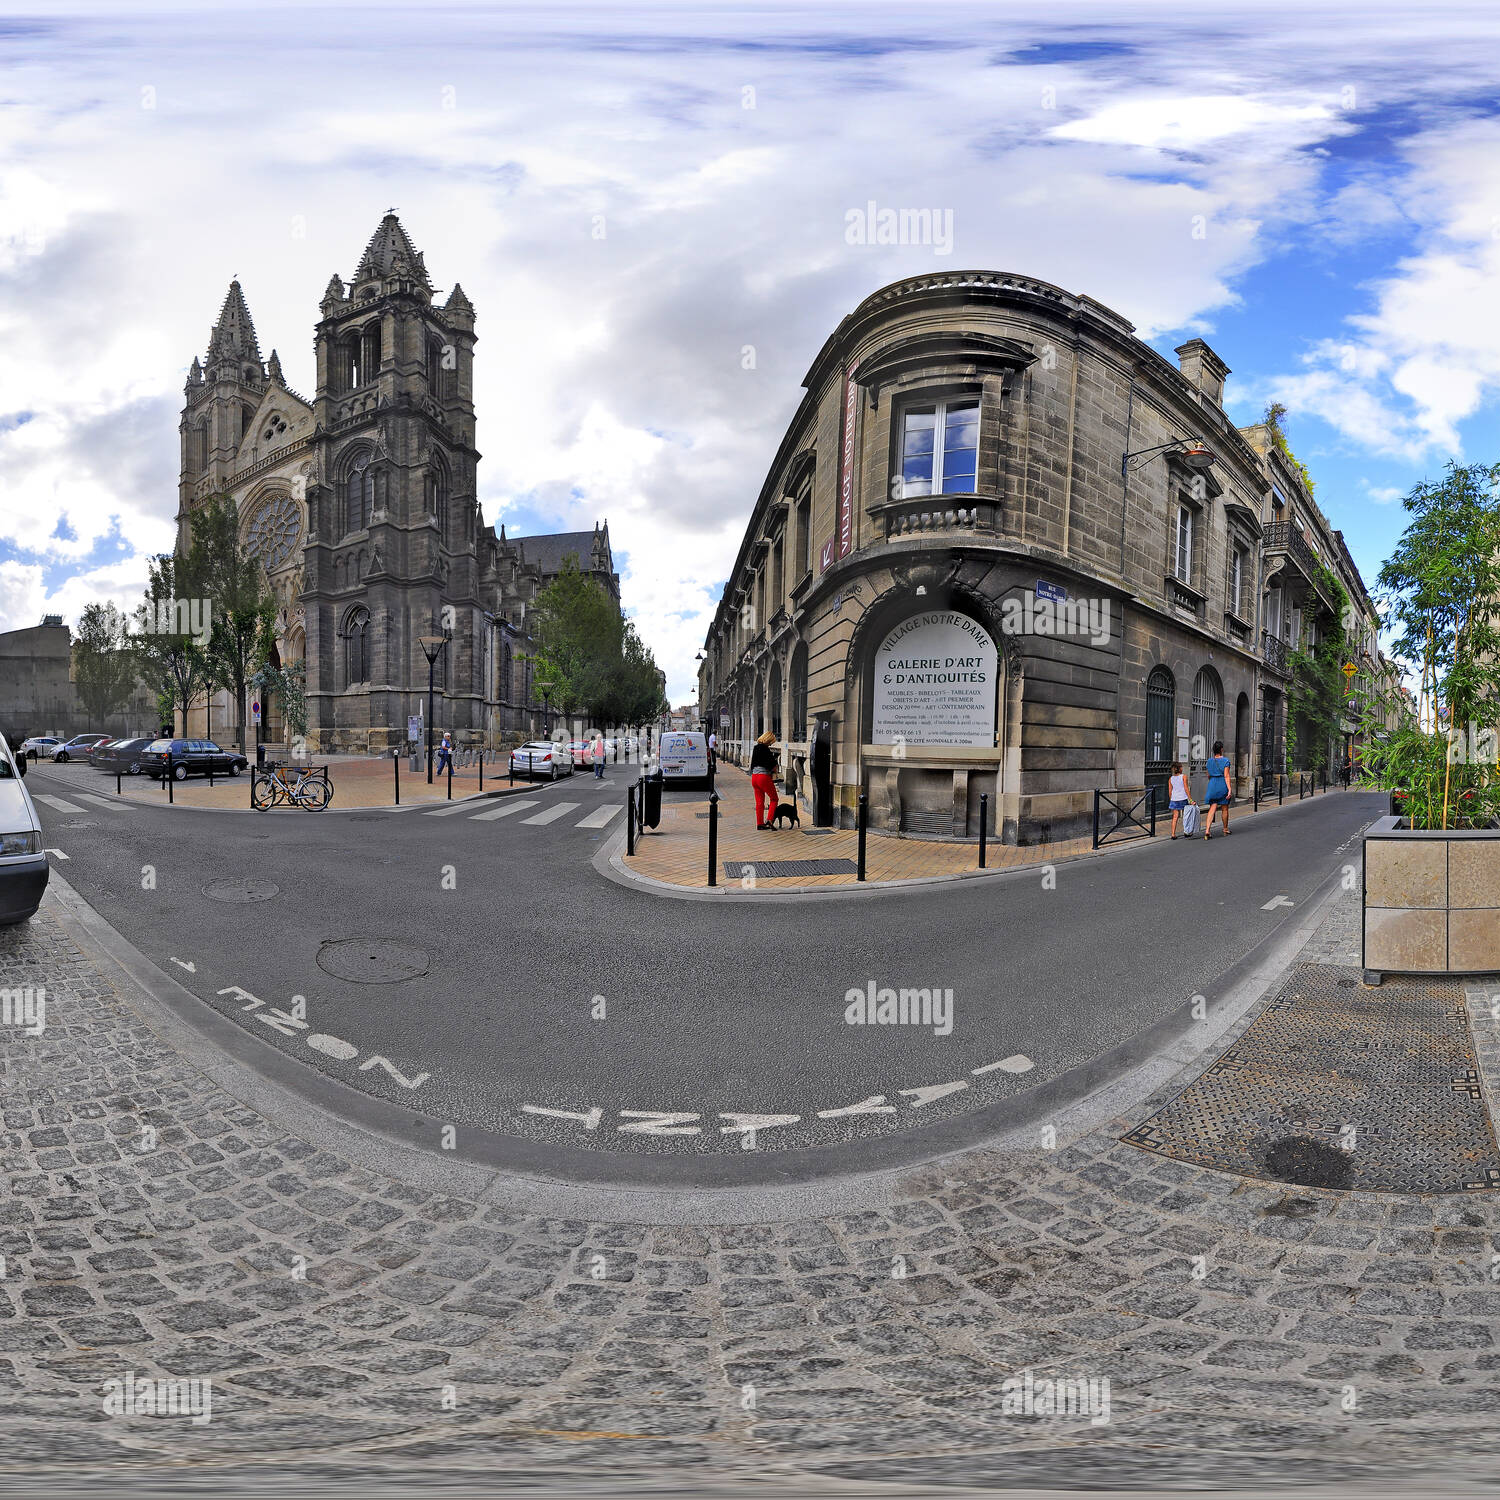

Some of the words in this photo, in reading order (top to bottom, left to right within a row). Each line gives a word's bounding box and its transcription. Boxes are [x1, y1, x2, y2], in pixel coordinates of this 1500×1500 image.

[844, 409, 853, 467] NOTRE
[841, 470, 851, 554] VILLAGE
[882, 618, 921, 652] VILLAGE
[922, 614, 962, 627] NOTRE
[961, 620, 989, 649] DAME
[883, 674, 892, 684] &
[896, 669, 986, 684] D'ANTIQUITÉS
[888, 659, 941, 670] GALERIE
[945, 657, 984, 668] D'ART
[822, 721, 829, 729] P
[217, 985, 431, 1090] ZONE
[519, 1054, 1035, 1135] PAYANT
[1268, 1115, 1383, 1136] TELECOM
